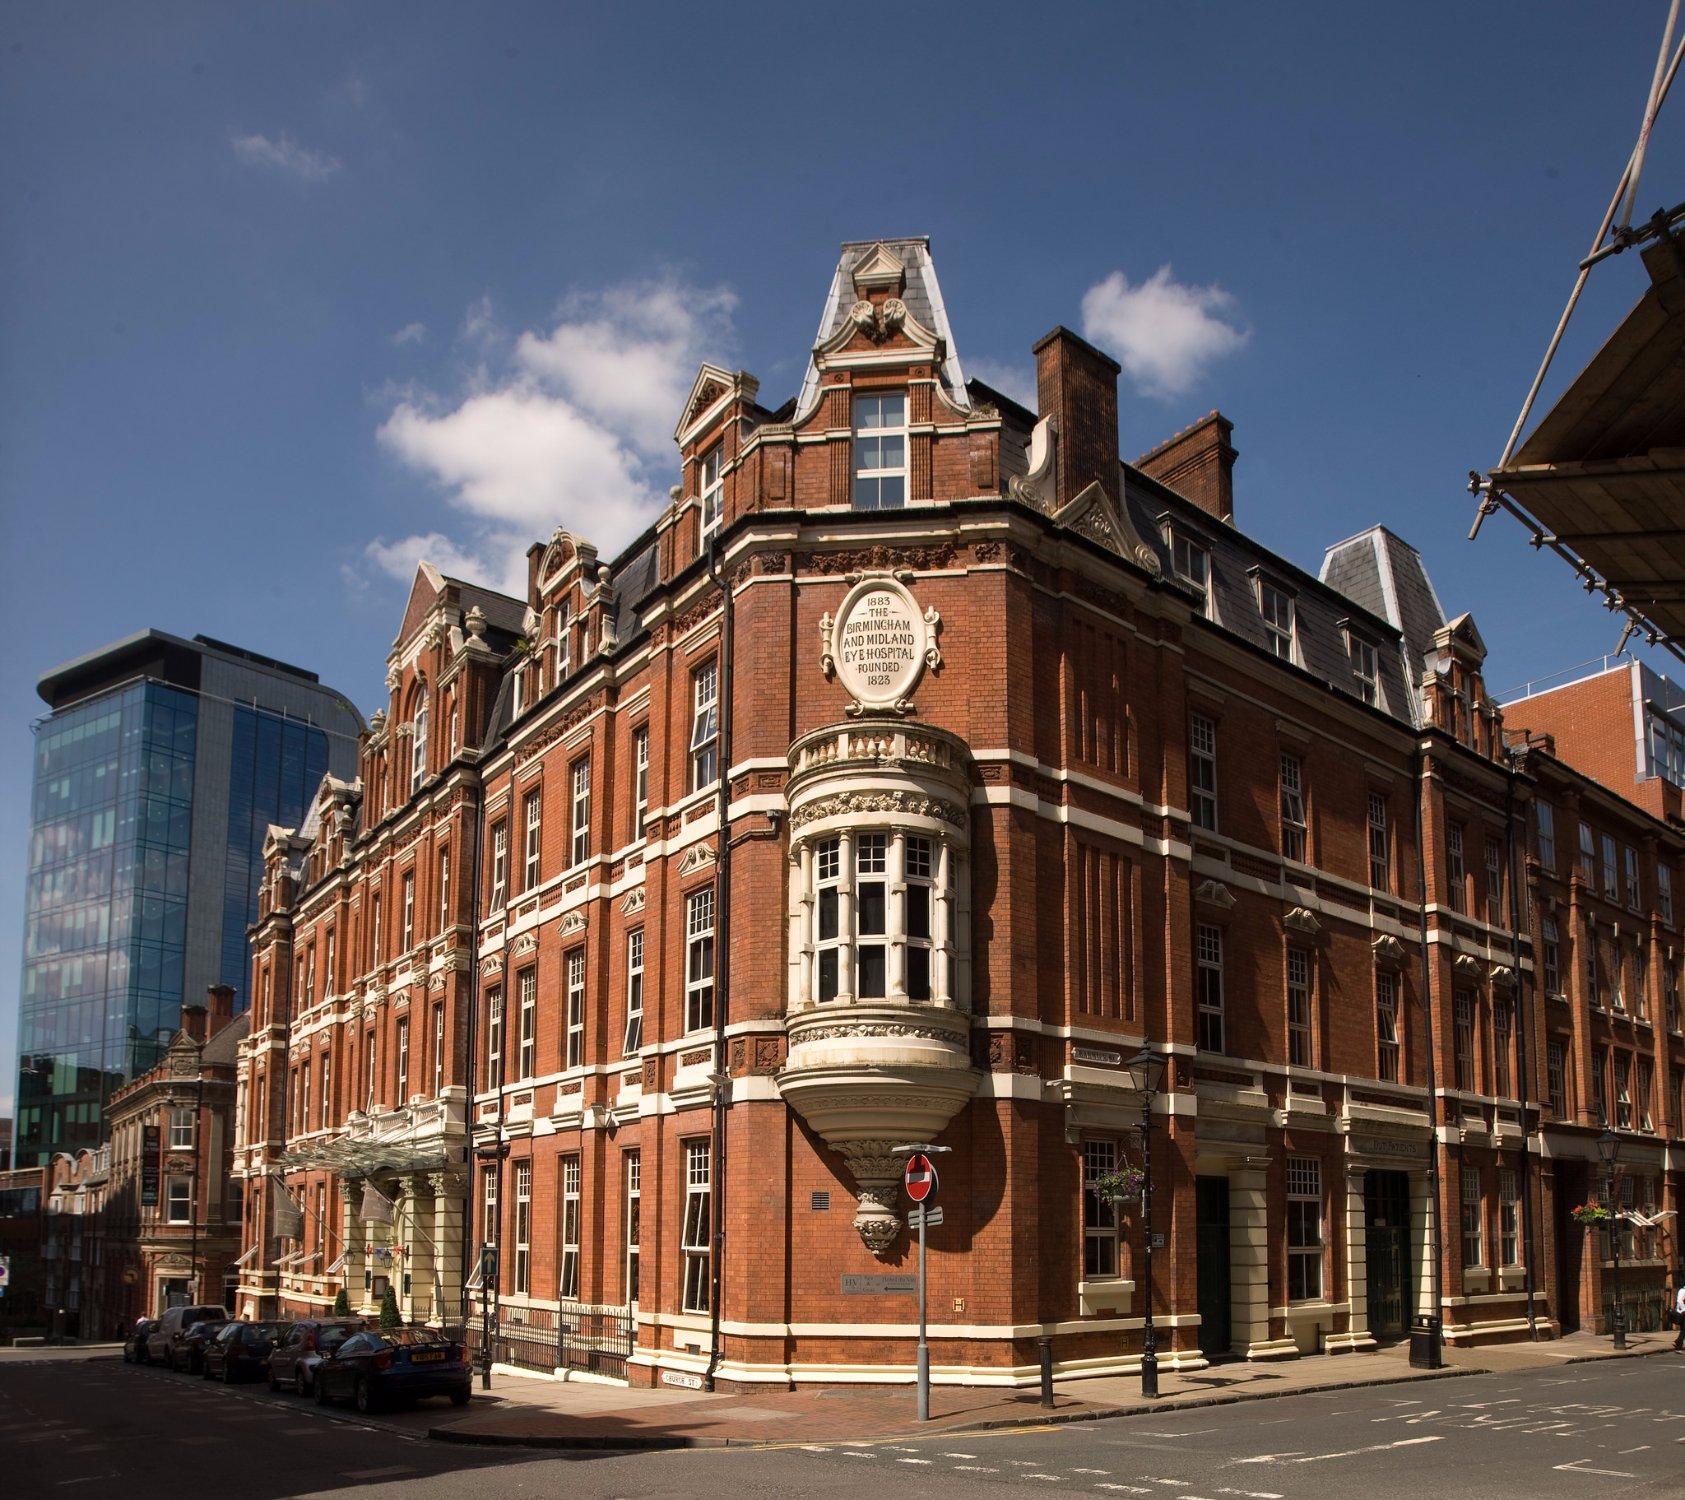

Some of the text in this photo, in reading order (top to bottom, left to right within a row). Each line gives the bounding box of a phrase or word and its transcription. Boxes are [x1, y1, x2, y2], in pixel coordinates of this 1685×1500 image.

[867, 597, 891, 606] 1883
[869, 608, 888, 617] THE
[846, 620, 911, 634] BIRMINGHAM
[844, 633, 914, 648] AND MIDLAND
[845, 648, 914, 662] EYE HOSPITAL
[859, 662, 899, 673] FOUNDED
[868, 675, 890, 685] 1823
